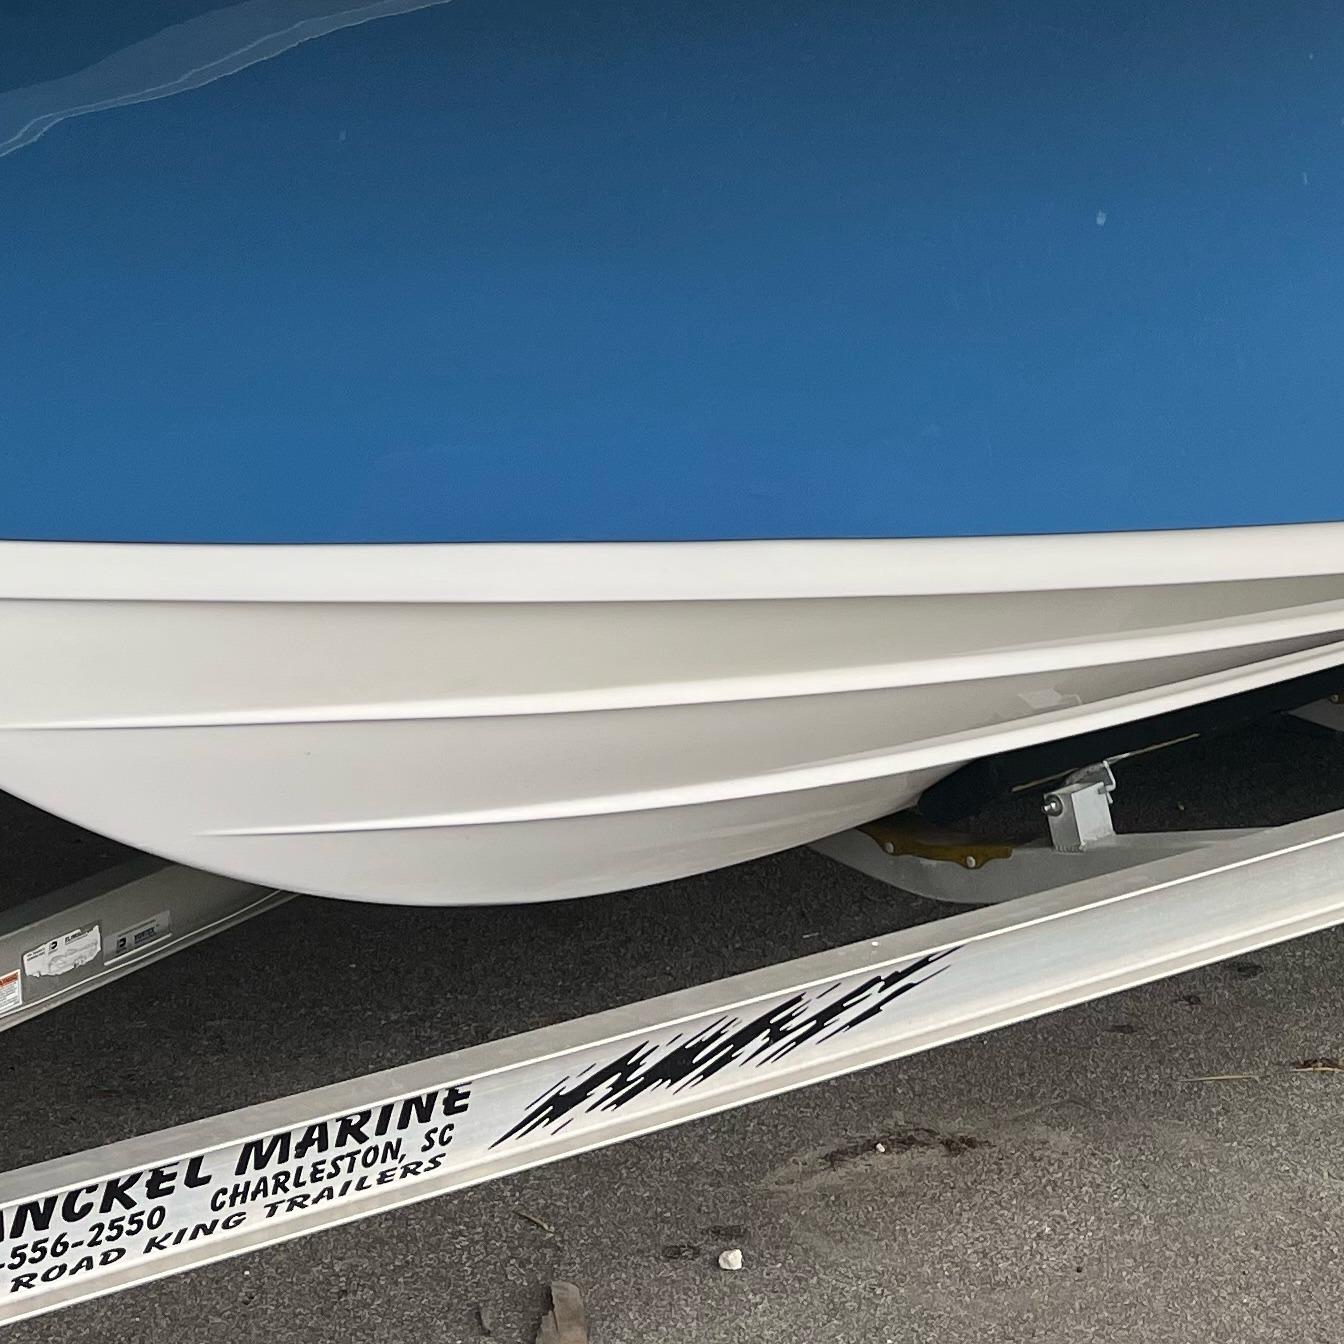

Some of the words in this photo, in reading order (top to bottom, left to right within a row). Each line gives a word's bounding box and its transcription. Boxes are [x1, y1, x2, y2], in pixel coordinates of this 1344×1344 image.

[210, 1138, 406, 1212] CHARLESTON,
[421, 1123, 455, 1153] SC
[234, 1082, 472, 1176] MARINE
[10, 1247, 127, 1293] ROAD
[143, 1211, 247, 1254] KING
[264, 1153, 446, 1218] TRAILERS
